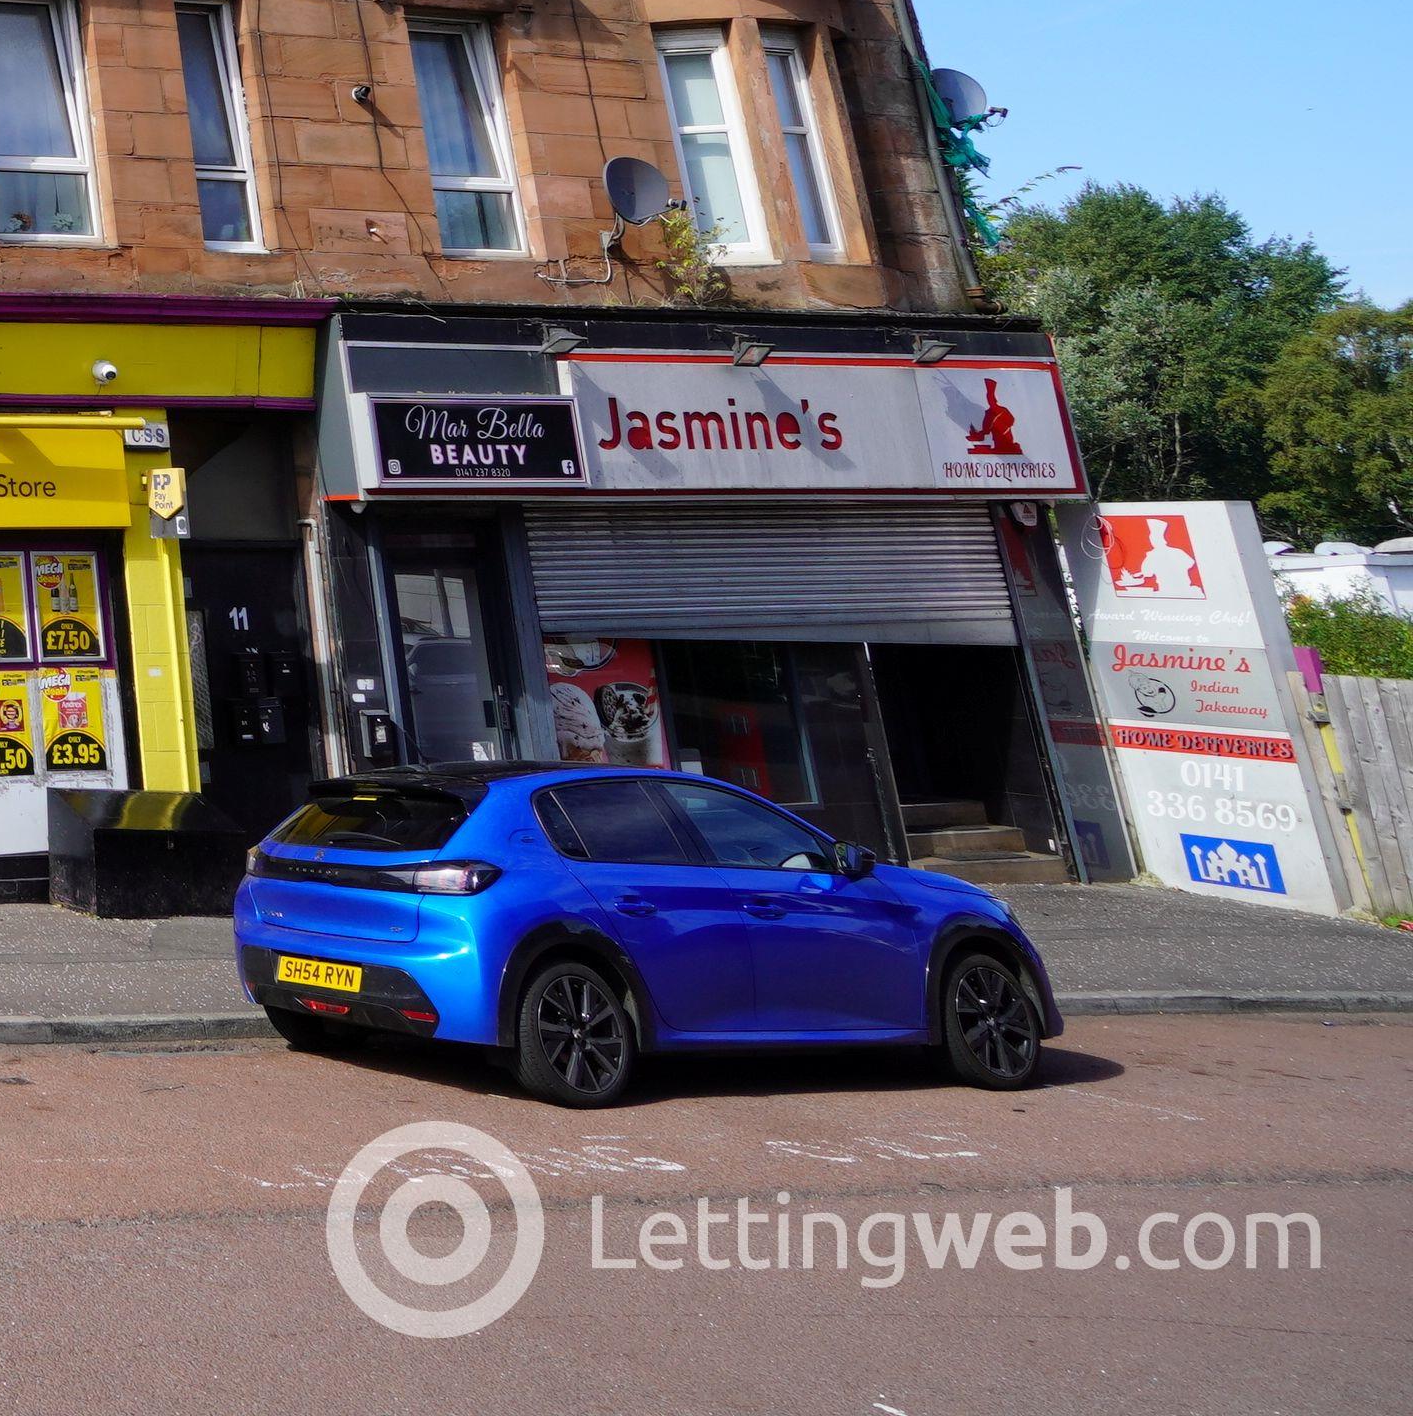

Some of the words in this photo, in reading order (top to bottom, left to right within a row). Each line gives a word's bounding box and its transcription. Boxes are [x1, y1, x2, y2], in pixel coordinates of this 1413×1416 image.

[405, 405, 469, 442] Mar
[477, 407, 545, 439] Bella
[598, 397, 843, 450] Jasmine's
[429, 444, 526, 465] BEAUTY
[455, 468, 473, 477] 0141
[475, 468, 489, 477] 237
[491, 468, 511, 477] 8320
[943, 462, 981, 478] HOME
[984, 462, 1056, 482] DELIVERIES
[155, 492, 166, 501] Pay
[155, 501, 173, 509] Point
[35, 562, 63, 576] MEGA
[229, 606, 249, 631] 11
[1088, 609, 1134, 622] Award
[1140, 609, 1203, 625] Winning
[1209, 610, 1252, 625] Chef!
[46, 630, 90, 650] £7.50
[1133, 630, 1191, 643] Welcome
[1197, 634, 1209, 643] to
[1112, 644, 1251, 673] Jasmine's
[40, 674, 71, 690] MEGA
[1190, 680, 1239, 695] Indian
[1195, 699, 1269, 719] Takeaway
[1116, 729, 1174, 748] HOME
[1177, 734, 1293, 759] DELIVERIES
[52, 744, 100, 765] £3.95
[1180, 760, 1244, 791] 0141
[1147, 790, 1207, 822] 336
[1214, 797, 1296, 832] 8569
[285, 961, 320, 982] SH54
[325, 966, 354, 987] RYN
